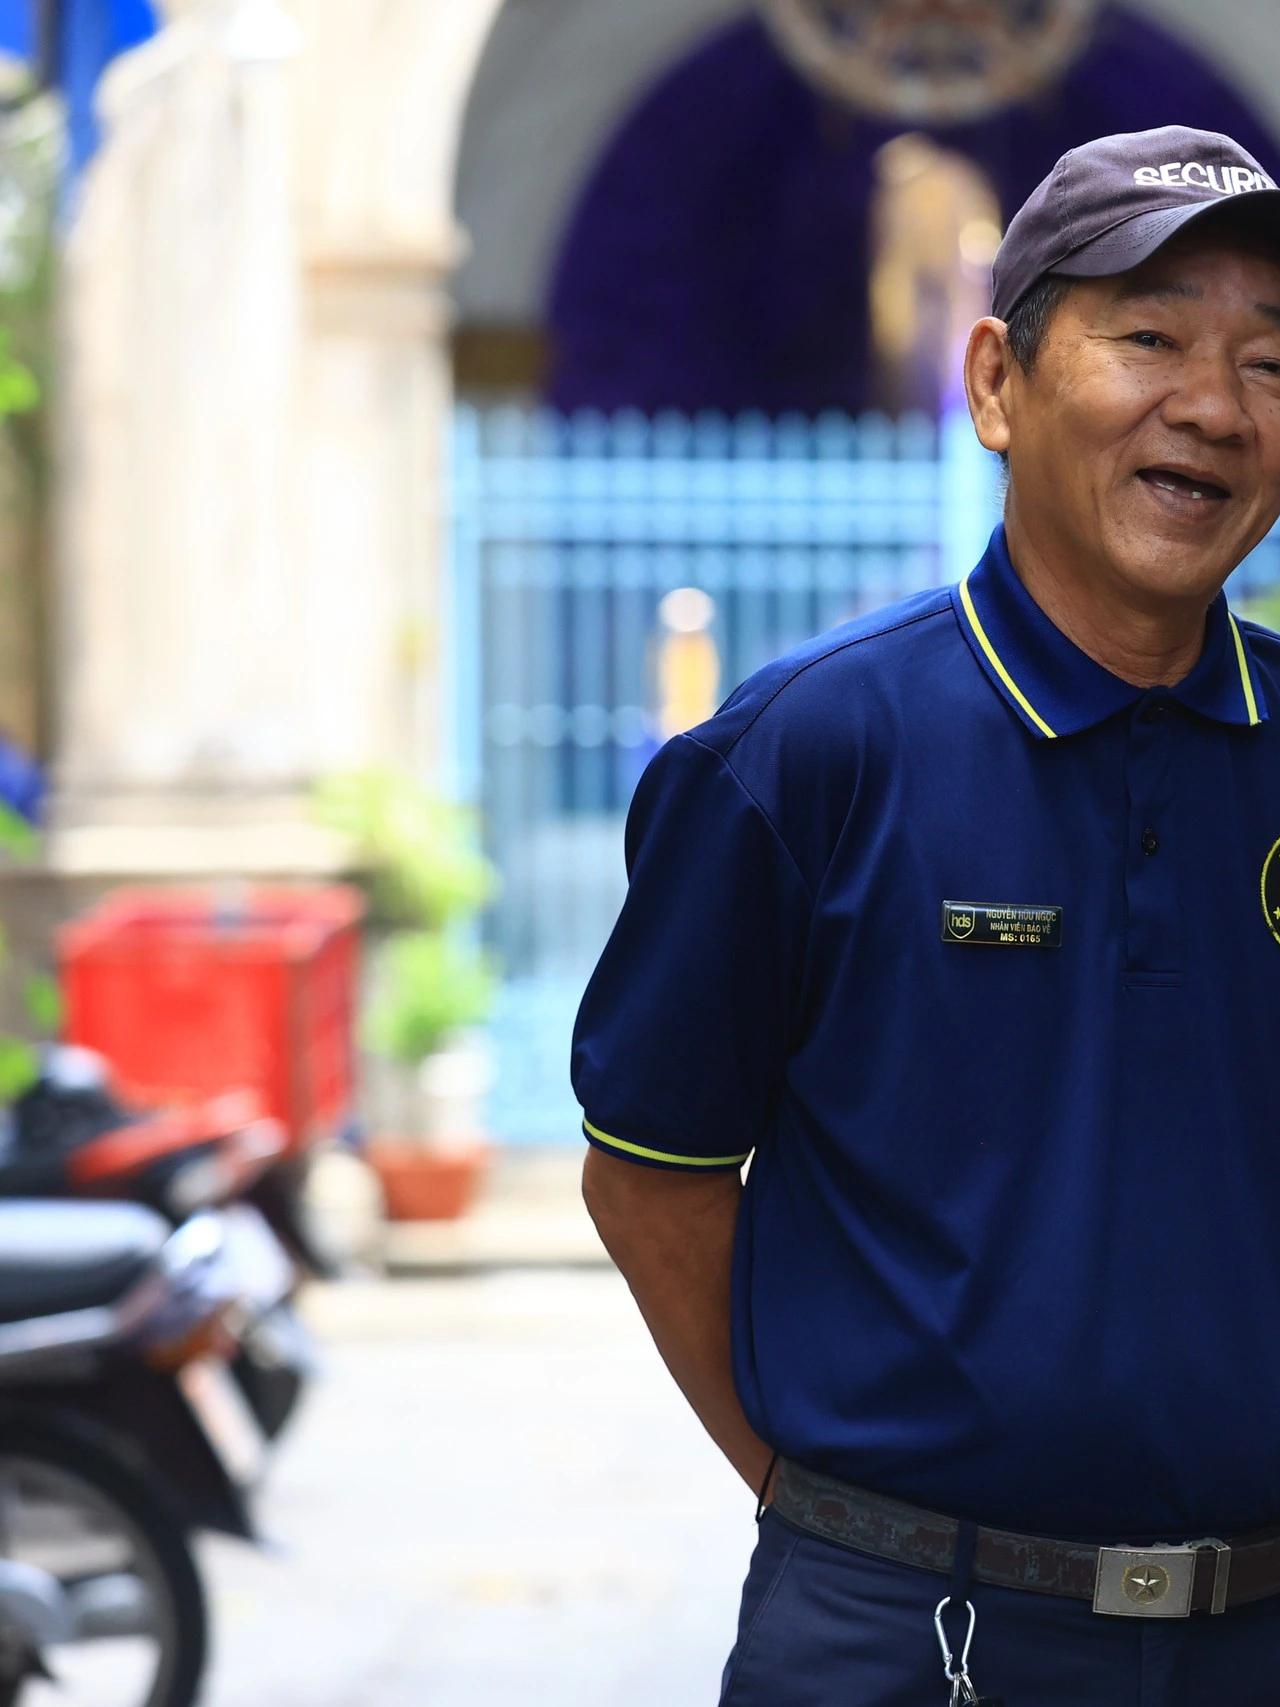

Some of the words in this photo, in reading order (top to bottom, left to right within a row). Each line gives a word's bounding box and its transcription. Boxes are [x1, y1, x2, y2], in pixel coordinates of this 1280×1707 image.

[951, 913, 971, 928] hds
[990, 921, 1009, 932] NHÂN
[1010, 922, 1026, 932] VIÊN
[1000, 933, 1017, 942] MS:
[1020, 934, 1041, 943] 0165
